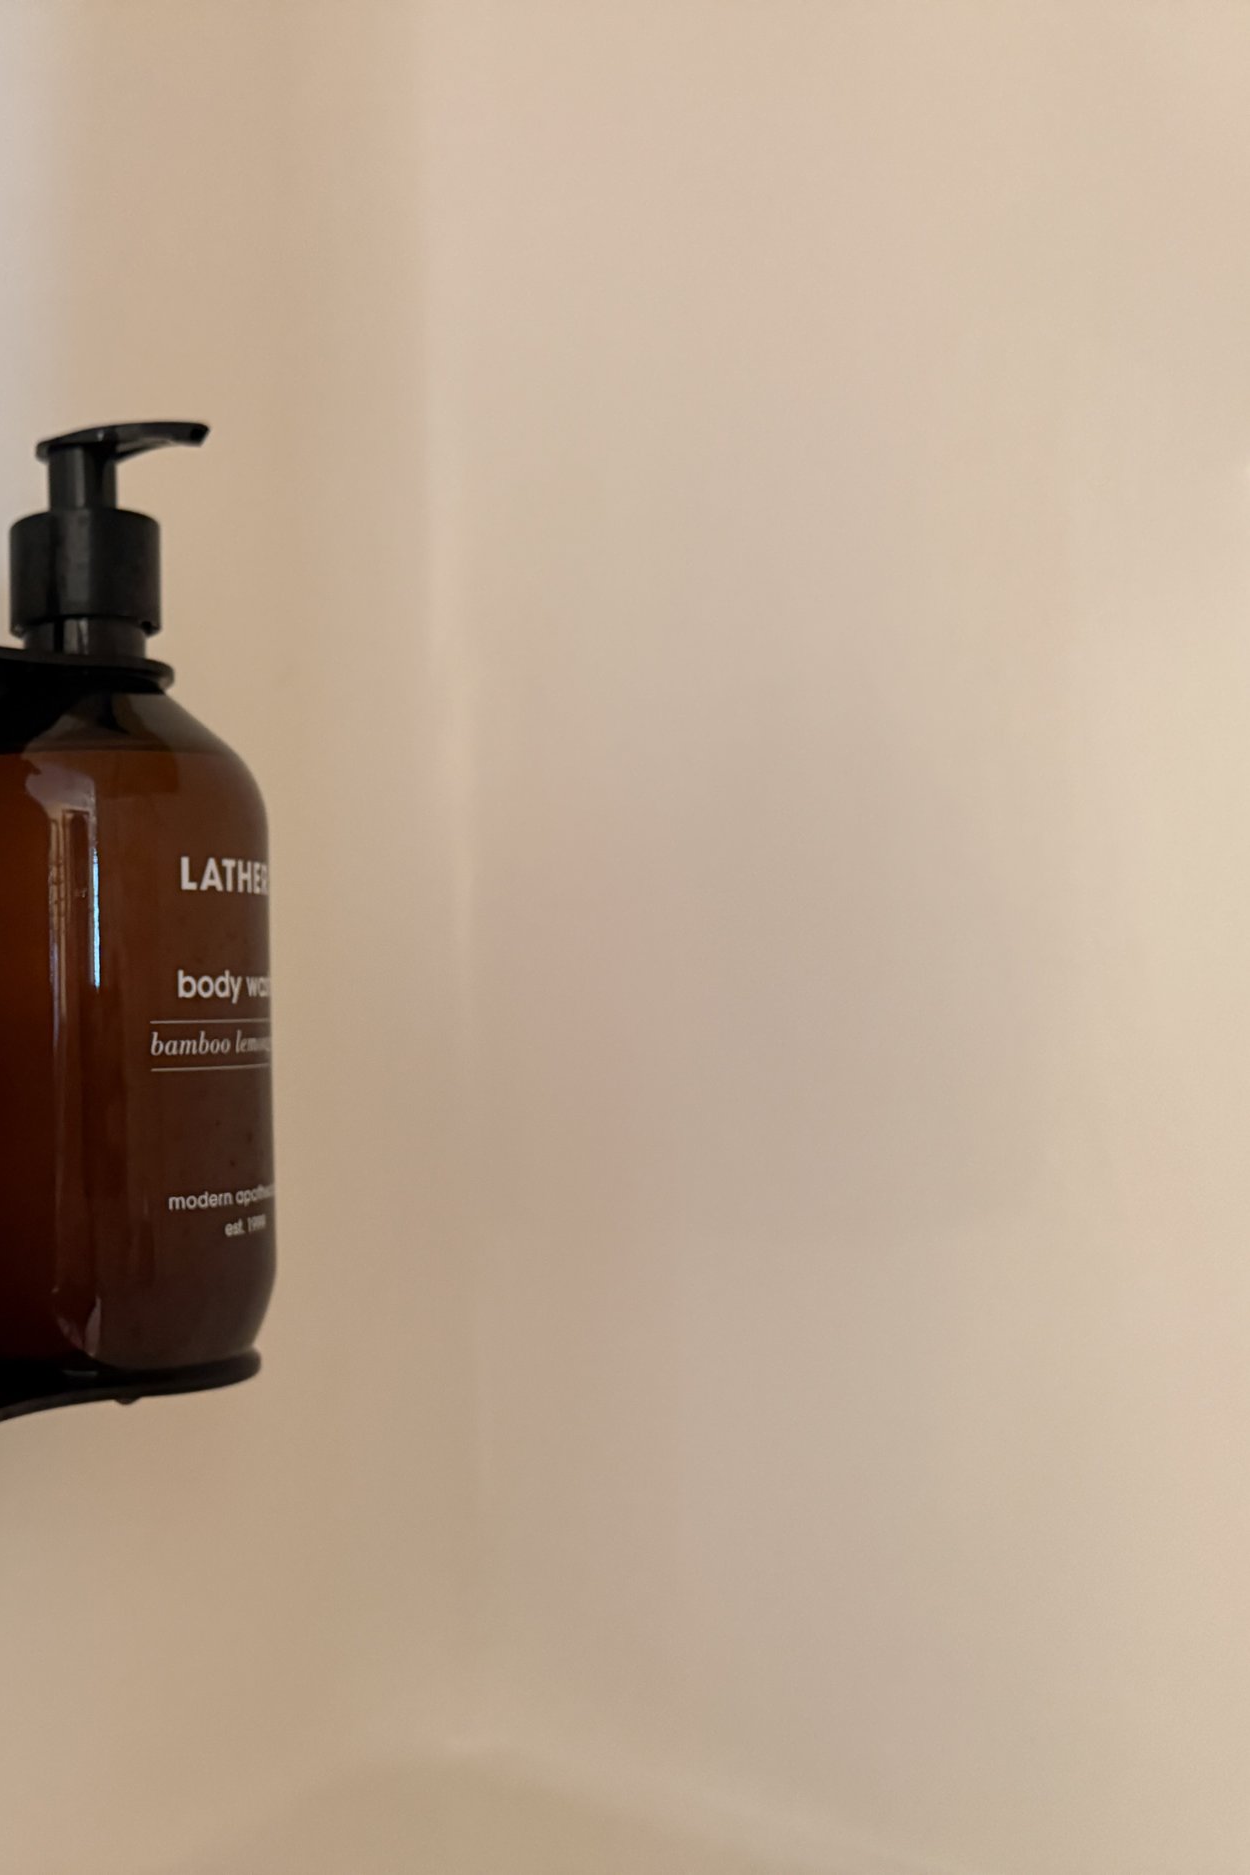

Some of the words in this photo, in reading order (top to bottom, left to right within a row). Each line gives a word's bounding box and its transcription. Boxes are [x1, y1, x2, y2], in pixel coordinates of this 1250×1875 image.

[177, 969, 243, 1004] body
[150, 1031, 231, 1056] bamboo
[168, 1190, 233, 1211] modern
